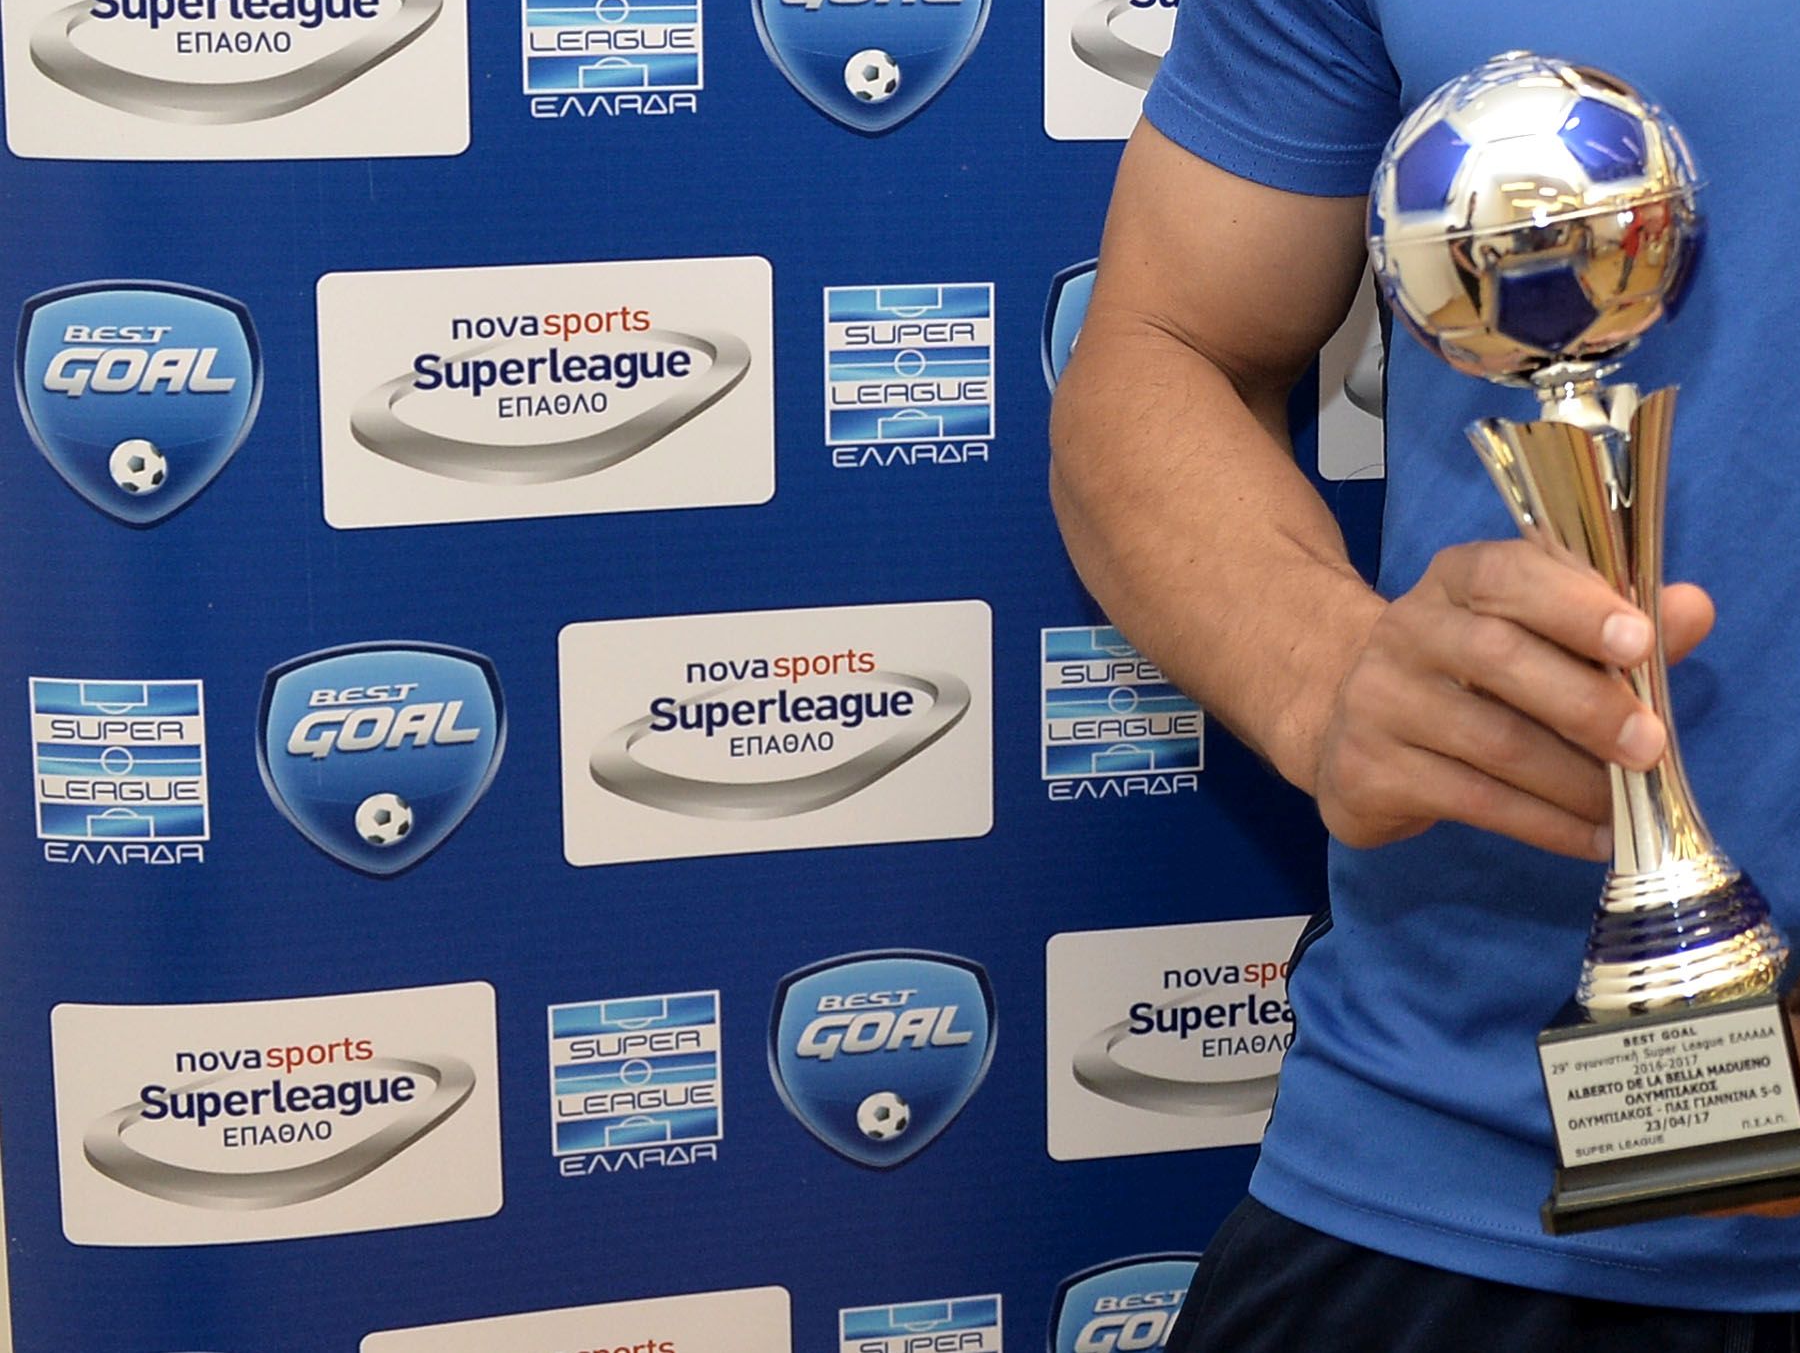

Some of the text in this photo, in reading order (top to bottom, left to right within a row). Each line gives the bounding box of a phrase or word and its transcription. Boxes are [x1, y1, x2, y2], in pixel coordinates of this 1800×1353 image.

[178, 32, 290, 53] ΕΠΑΘΛΟ
[530, 29, 694, 51] LEAGUE
[65, 324, 174, 343] BEST
[453, 307, 650, 341] novasports
[845, 323, 974, 345] SUPER
[43, 345, 236, 395] GOAL
[414, 348, 690, 396] Superleague
[832, 381, 987, 404] LEAGUE
[499, 393, 607, 417] ΕΠΑΘΛΟ
[687, 650, 874, 683] novasports
[650, 690, 913, 736] Superleague
[51, 720, 183, 740] SUPER
[287, 700, 481, 757] GOAL
[1049, 716, 1195, 740] LEAGUE
[731, 732, 833, 756] ΕΠΑΘΛΟ
[41, 779, 200, 800] LEAGUE
[796, 1004, 974, 1058] GOAL
[1623, 1027, 1697, 1047] BEST GOAL
[177, 1038, 372, 1073] novasports
[570, 1031, 700, 1059] SUPER
[1643, 1044, 1676, 1058] Super
[1682, 1037, 1723, 1051] League
[1633, 1054, 1698, 1075] 2016-2017
[1567, 1082, 1624, 1101] ALBERTO
[1626, 1078, 1643, 1090] DE
[1646, 1075, 1663, 1086] LA
[1665, 1068, 1704, 1083] BELLA
[1625, 1080, 1718, 1105] ΟΛΥΜΠΙΑΚΟΣ
[141, 1077, 414, 1126] Superleague
[558, 1085, 714, 1117] LEAGUE
[1568, 1107, 1653, 1130] ΟΛΥΜΠΙΑΚΟΣ
[1664, 1099, 1690, 1113] ΠΑΣ
[1693, 1089, 1758, 1108] ΓΙΑΝΝΙΝΑ
[224, 1121, 331, 1146] ΕΠΑΘΛΟ
[1645, 1111, 1709, 1132] 23/04/17
[1575, 1135, 1665, 1158] SUPER LEAGUE
